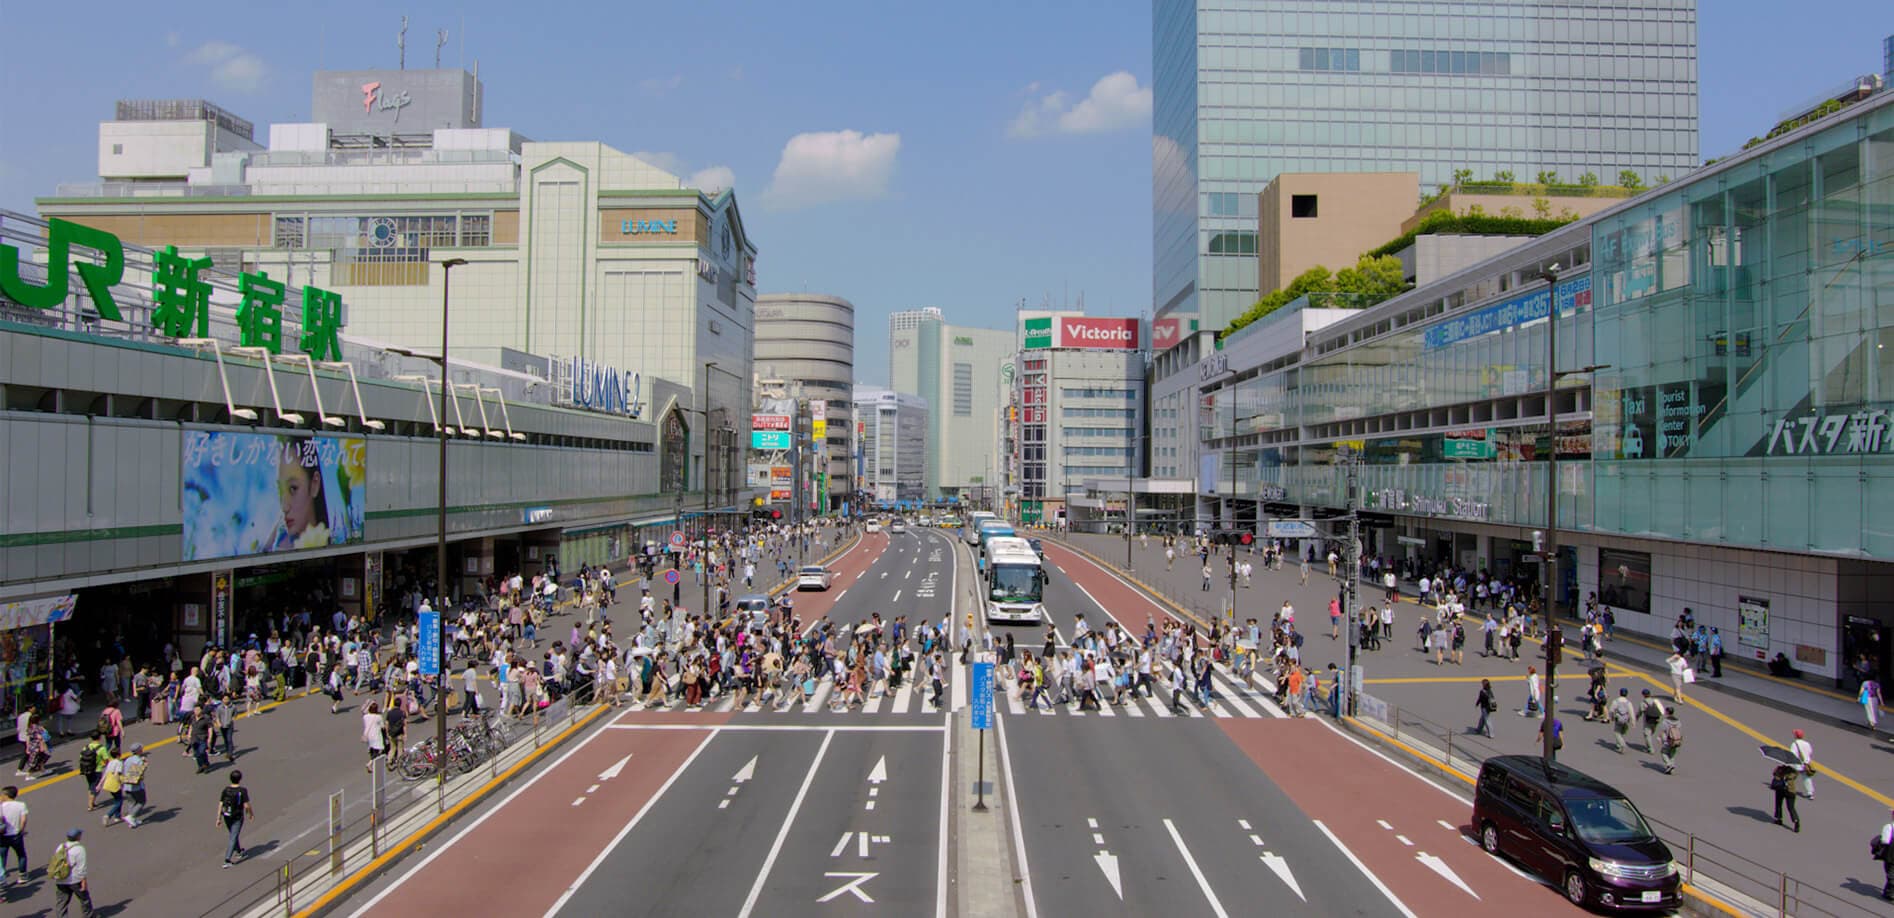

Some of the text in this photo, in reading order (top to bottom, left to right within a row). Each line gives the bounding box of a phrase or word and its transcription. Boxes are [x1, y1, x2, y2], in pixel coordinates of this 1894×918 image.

[361, 81, 412, 124] Flags
[620, 218, 678, 234] LUMINE
[0, 217, 343, 362] JR 新宿駅
[1067, 324, 1133, 340] Victoria
[572, 354, 640, 416] LUMINE 2
[1622, 395, 1646, 415] Taxi
[1766, 409, 1894, 455] バスタ新
[815, 830, 891, 903] バス
